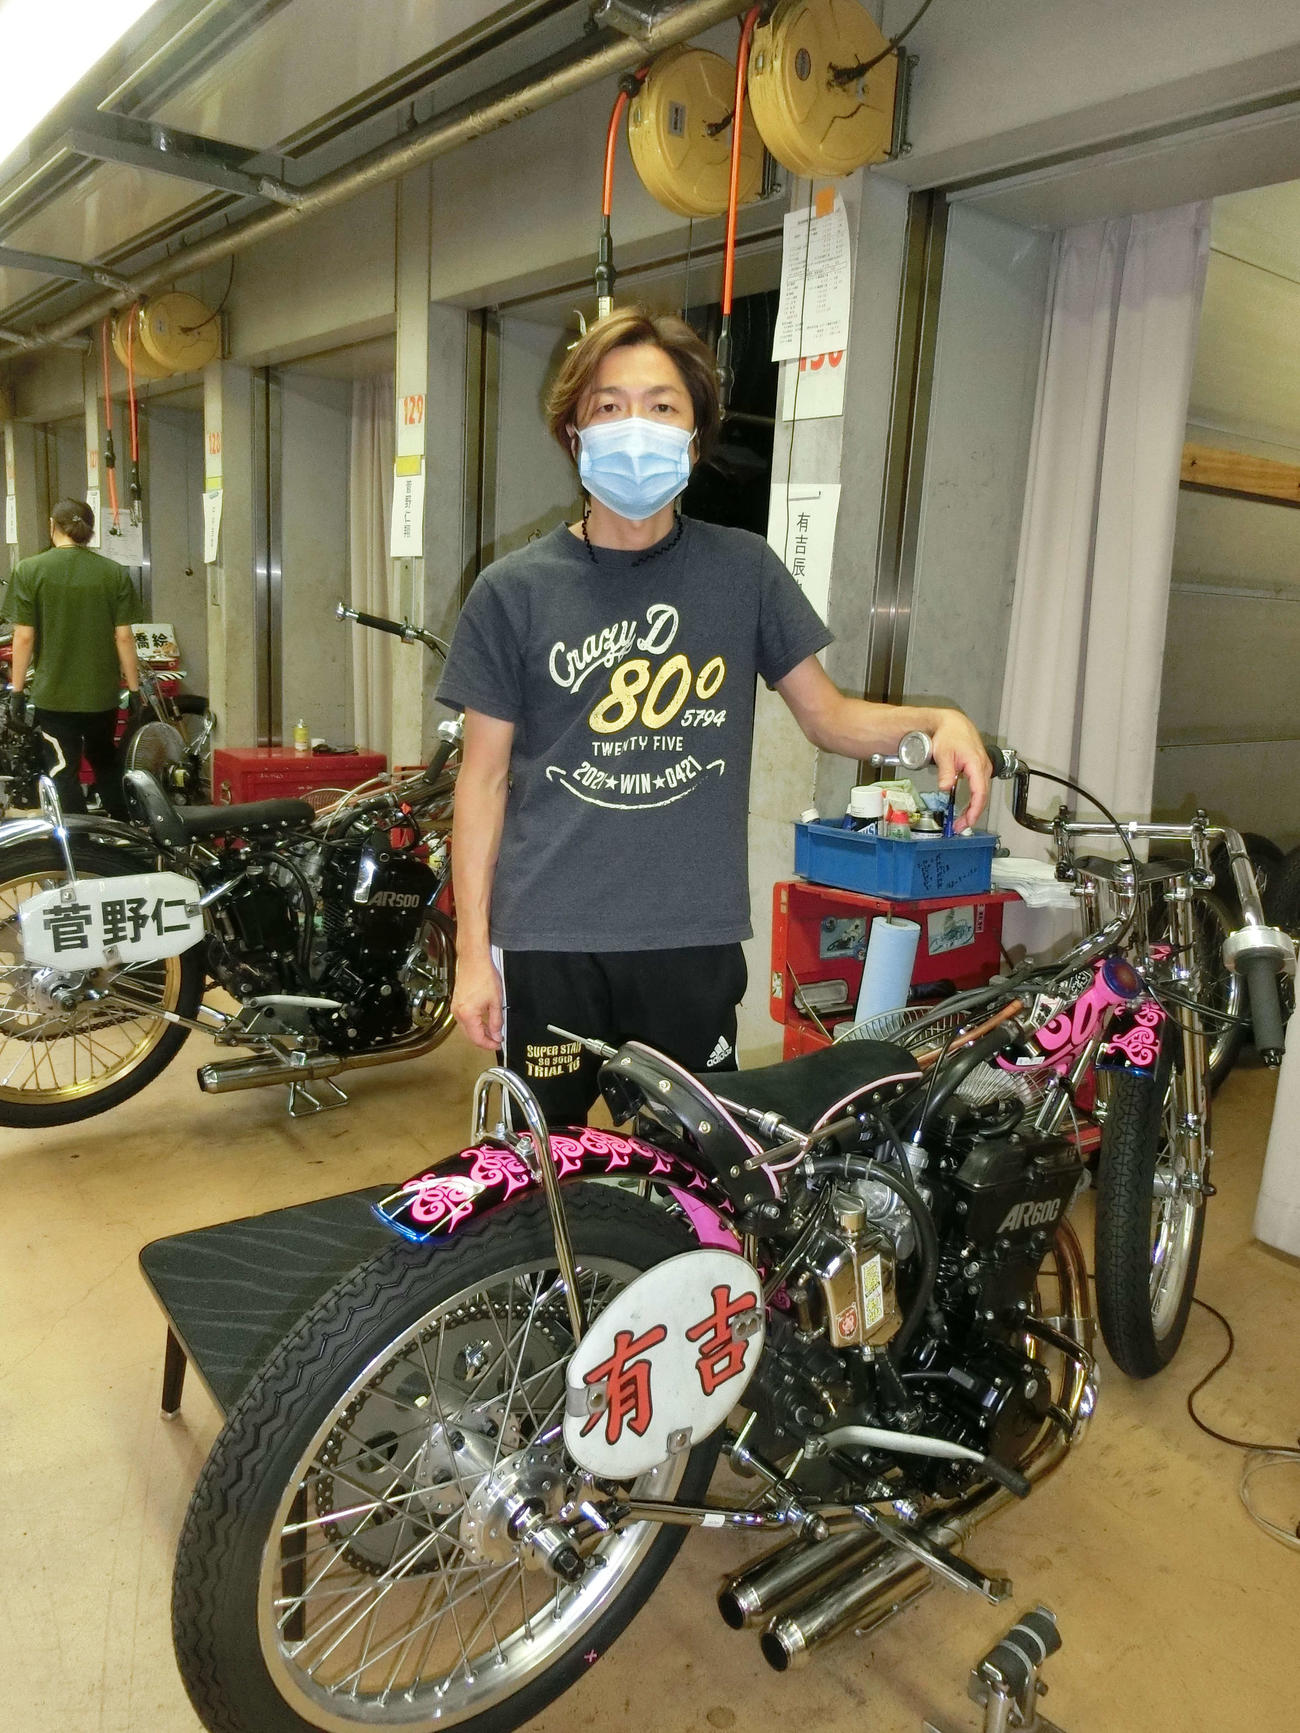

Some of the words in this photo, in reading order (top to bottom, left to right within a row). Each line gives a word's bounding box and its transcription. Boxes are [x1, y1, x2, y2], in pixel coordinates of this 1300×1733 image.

[403, 394, 424, 425] 129
[791, 512, 811, 589] 有吉辰
[549, 620, 637, 694] Crazy
[637, 603, 679, 654] D
[681, 709, 727, 727] 5794
[592, 735, 649, 757] TWENTY
[653, 736, 684, 751] FIVE
[43, 896, 191, 953] 菅野仁
[526, 1044, 559, 1058] SUPER
[706, 1046, 732, 1067] adidas
[525, 1060, 564, 1077] TRIAL
[580, 1284, 757, 1445] 有吉
